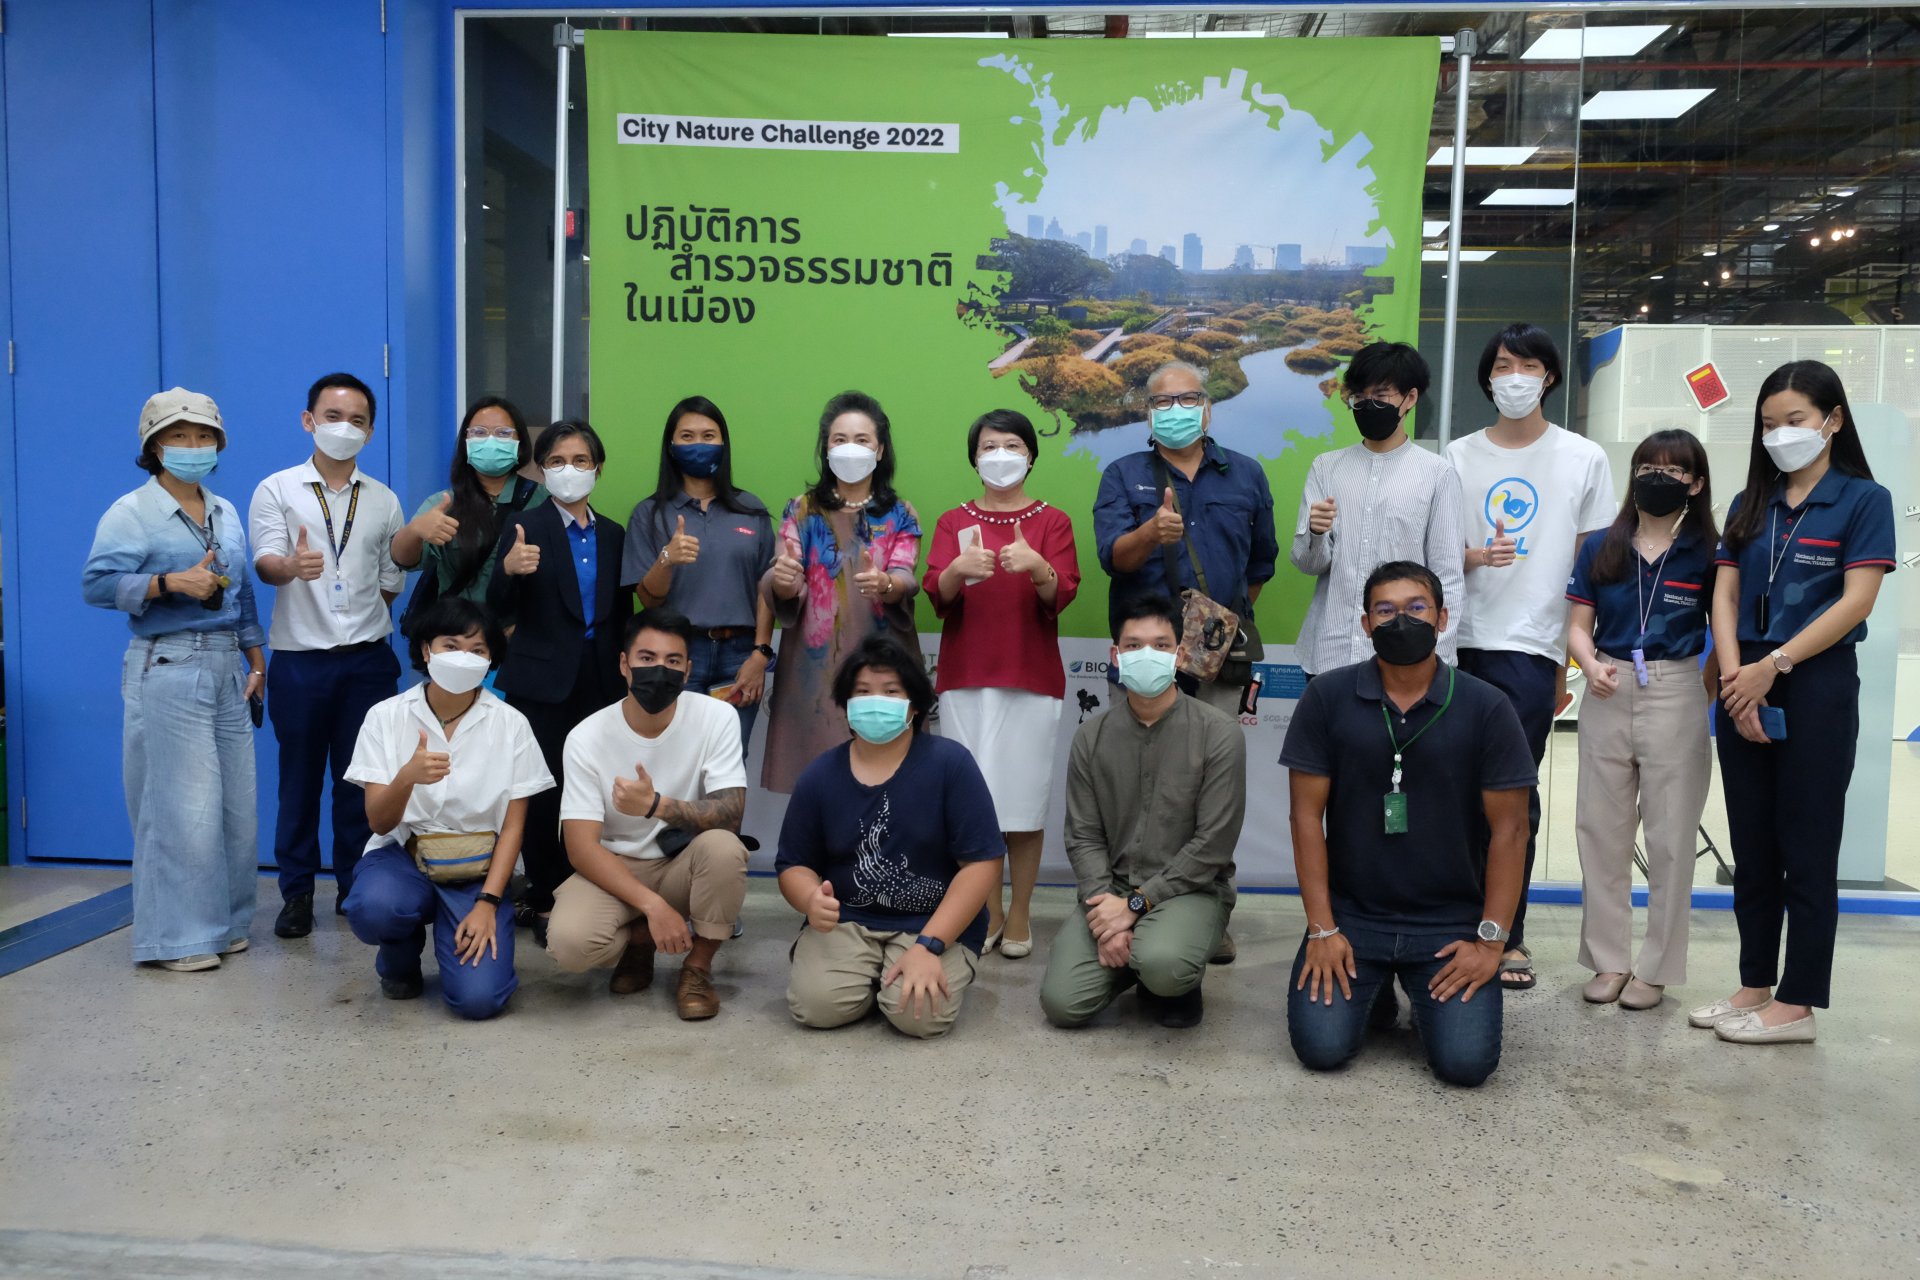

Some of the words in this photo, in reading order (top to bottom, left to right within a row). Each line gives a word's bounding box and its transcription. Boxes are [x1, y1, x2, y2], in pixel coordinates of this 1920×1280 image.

[623, 118, 669, 142] City
[676, 121, 755, 142] Nature
[761, 124, 880, 150] Challenge
[886, 128, 944, 147] 2022
[626, 204, 801, 251] ปฏิบัติการ
[670, 244, 953, 287] สำรวจธรรมชาติ
[624, 282, 756, 324] ในเมือง
